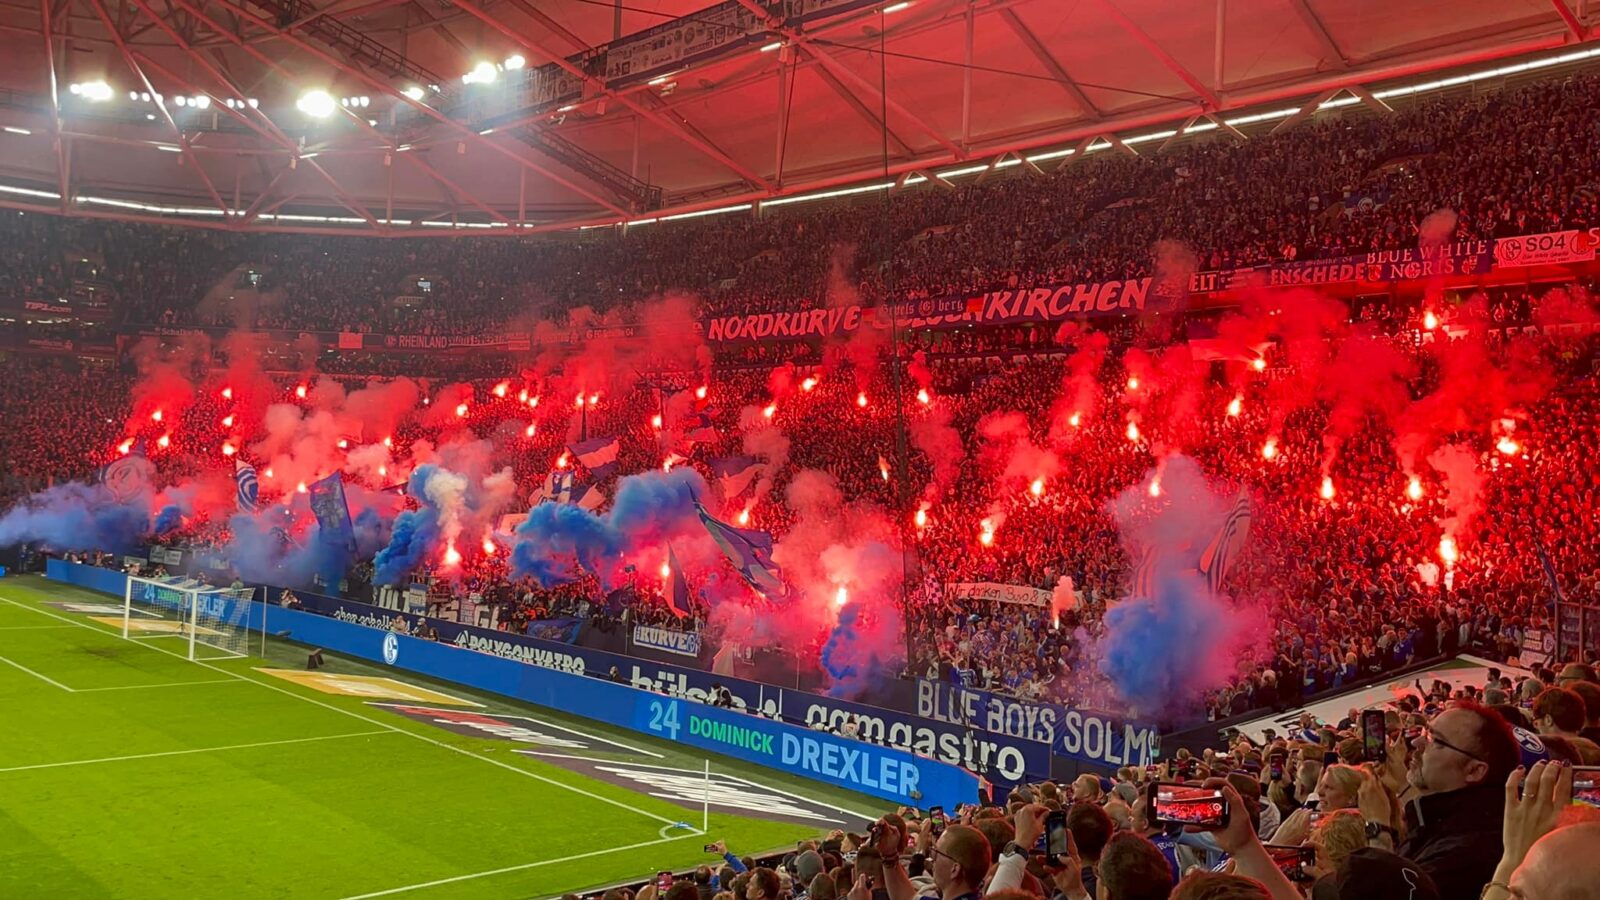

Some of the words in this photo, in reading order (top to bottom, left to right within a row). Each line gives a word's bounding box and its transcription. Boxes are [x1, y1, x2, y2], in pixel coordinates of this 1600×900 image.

[1366, 248, 1413, 264] BLUE
[1420, 240, 1488, 260] WHITE
[707, 305, 861, 342] NORDKURVE
[399, 334, 448, 349] RHEINLAND
[183, 592, 225, 618] DEXLER
[639, 627, 689, 652] KURVE
[630, 665, 748, 714] hülsa
[917, 679, 984, 730] BLUE
[987, 697, 1056, 745] BOYS
[649, 700, 681, 741] 24
[689, 715, 774, 755] DOMINICK
[781, 731, 921, 797] DREXLER
